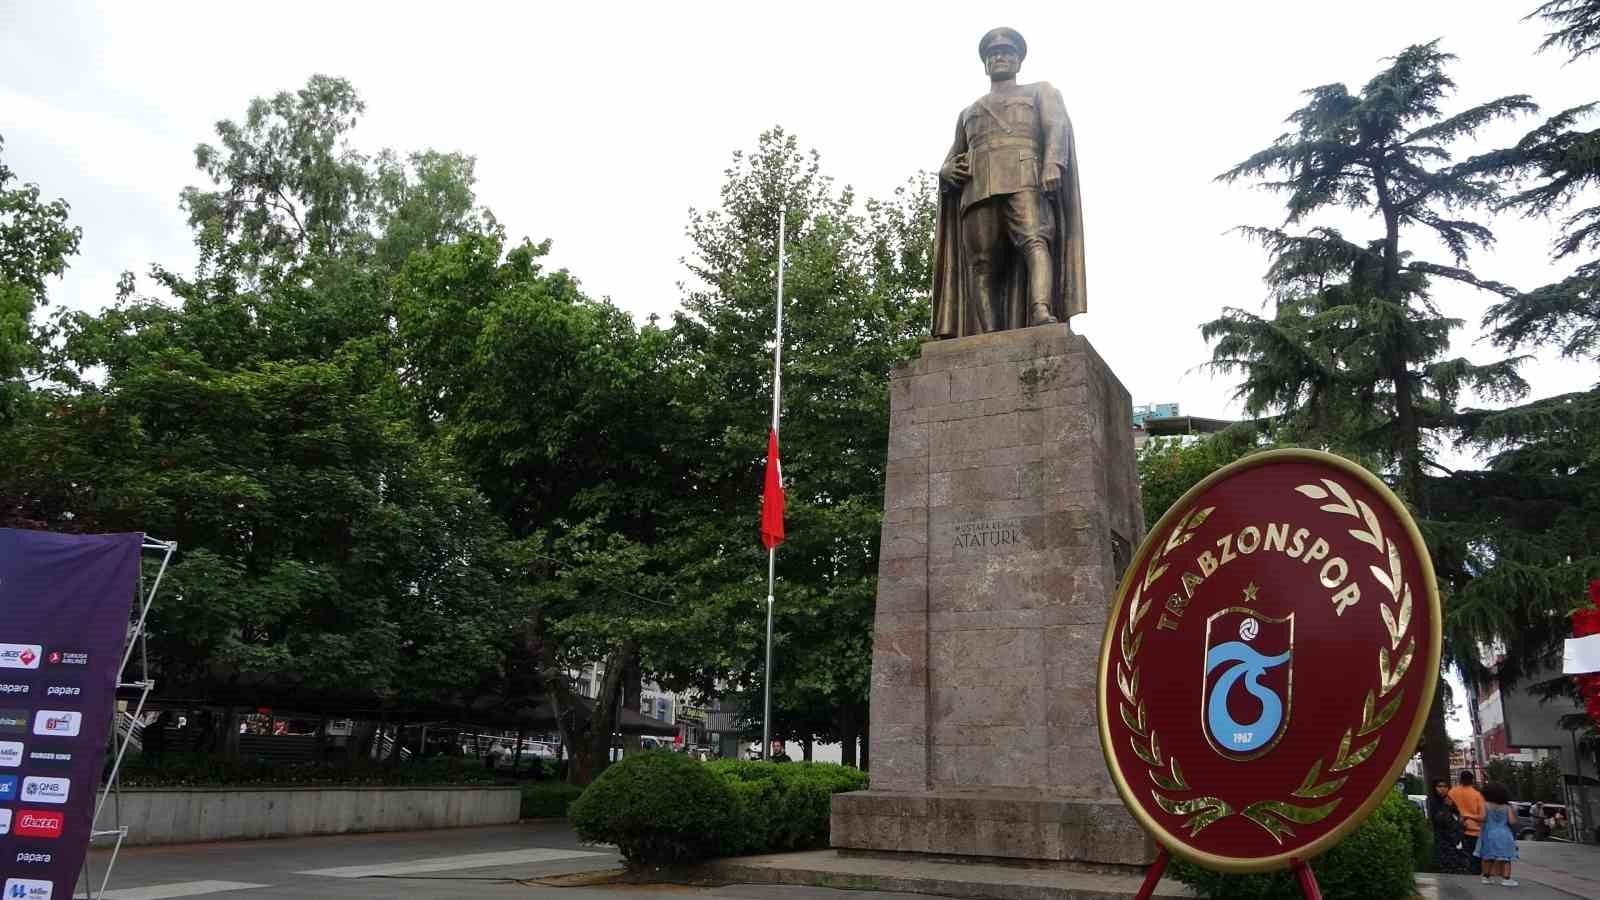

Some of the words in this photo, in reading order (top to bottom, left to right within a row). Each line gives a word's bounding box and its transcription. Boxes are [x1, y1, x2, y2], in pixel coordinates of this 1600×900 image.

[1156, 523, 1361, 631] TRABZONSPOR
[47, 686, 81, 696] papara
[1232, 733, 1254, 744] 1967
[39, 783, 60, 792] QNB
[16, 852, 51, 863] papara
